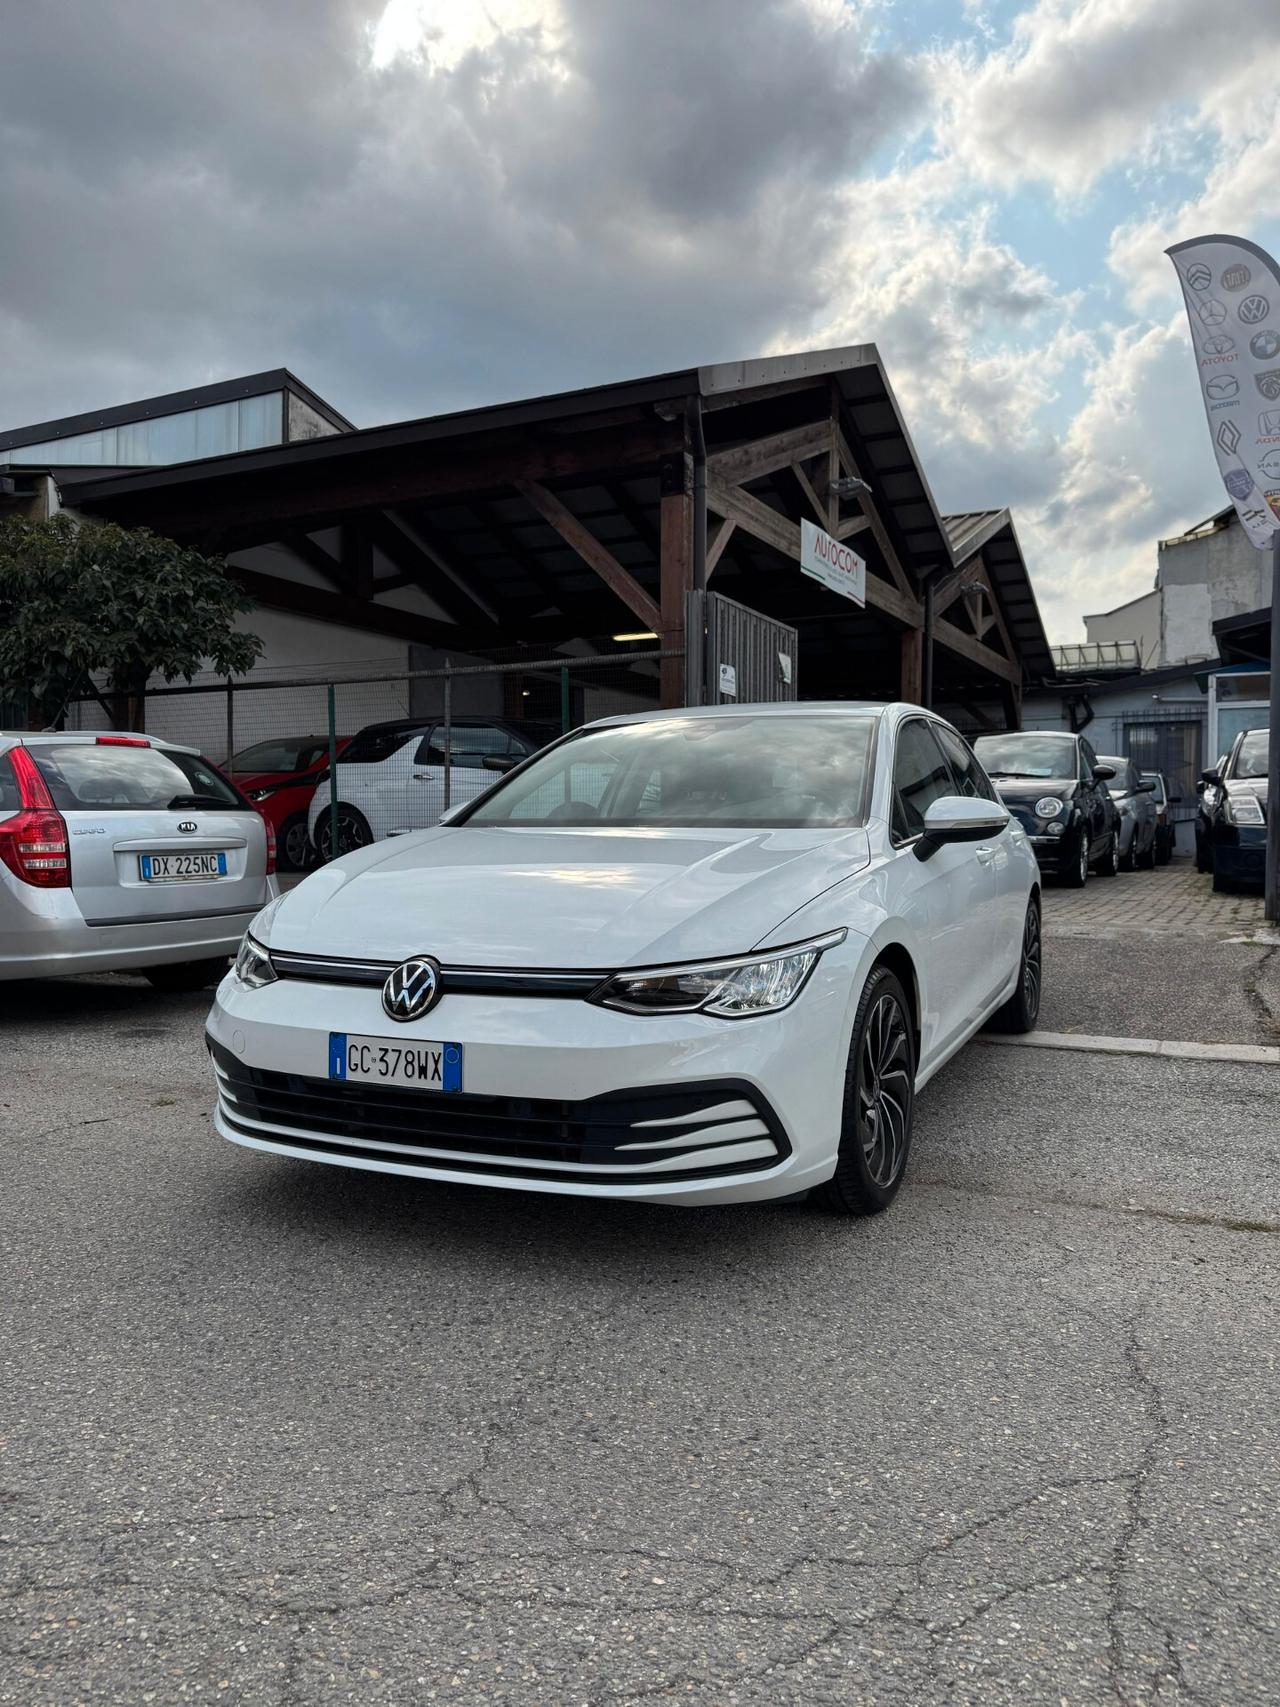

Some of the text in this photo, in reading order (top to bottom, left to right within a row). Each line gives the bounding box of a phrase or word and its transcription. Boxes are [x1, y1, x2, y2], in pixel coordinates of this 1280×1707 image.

[815, 533, 858, 579] AUTOCOM
[180, 822, 196, 831] KIA
[152, 857, 170, 876] DX
[175, 856, 217, 875] 225NC
[348, 1044, 371, 1074] GC
[378, 1047, 442, 1081] 378WX
